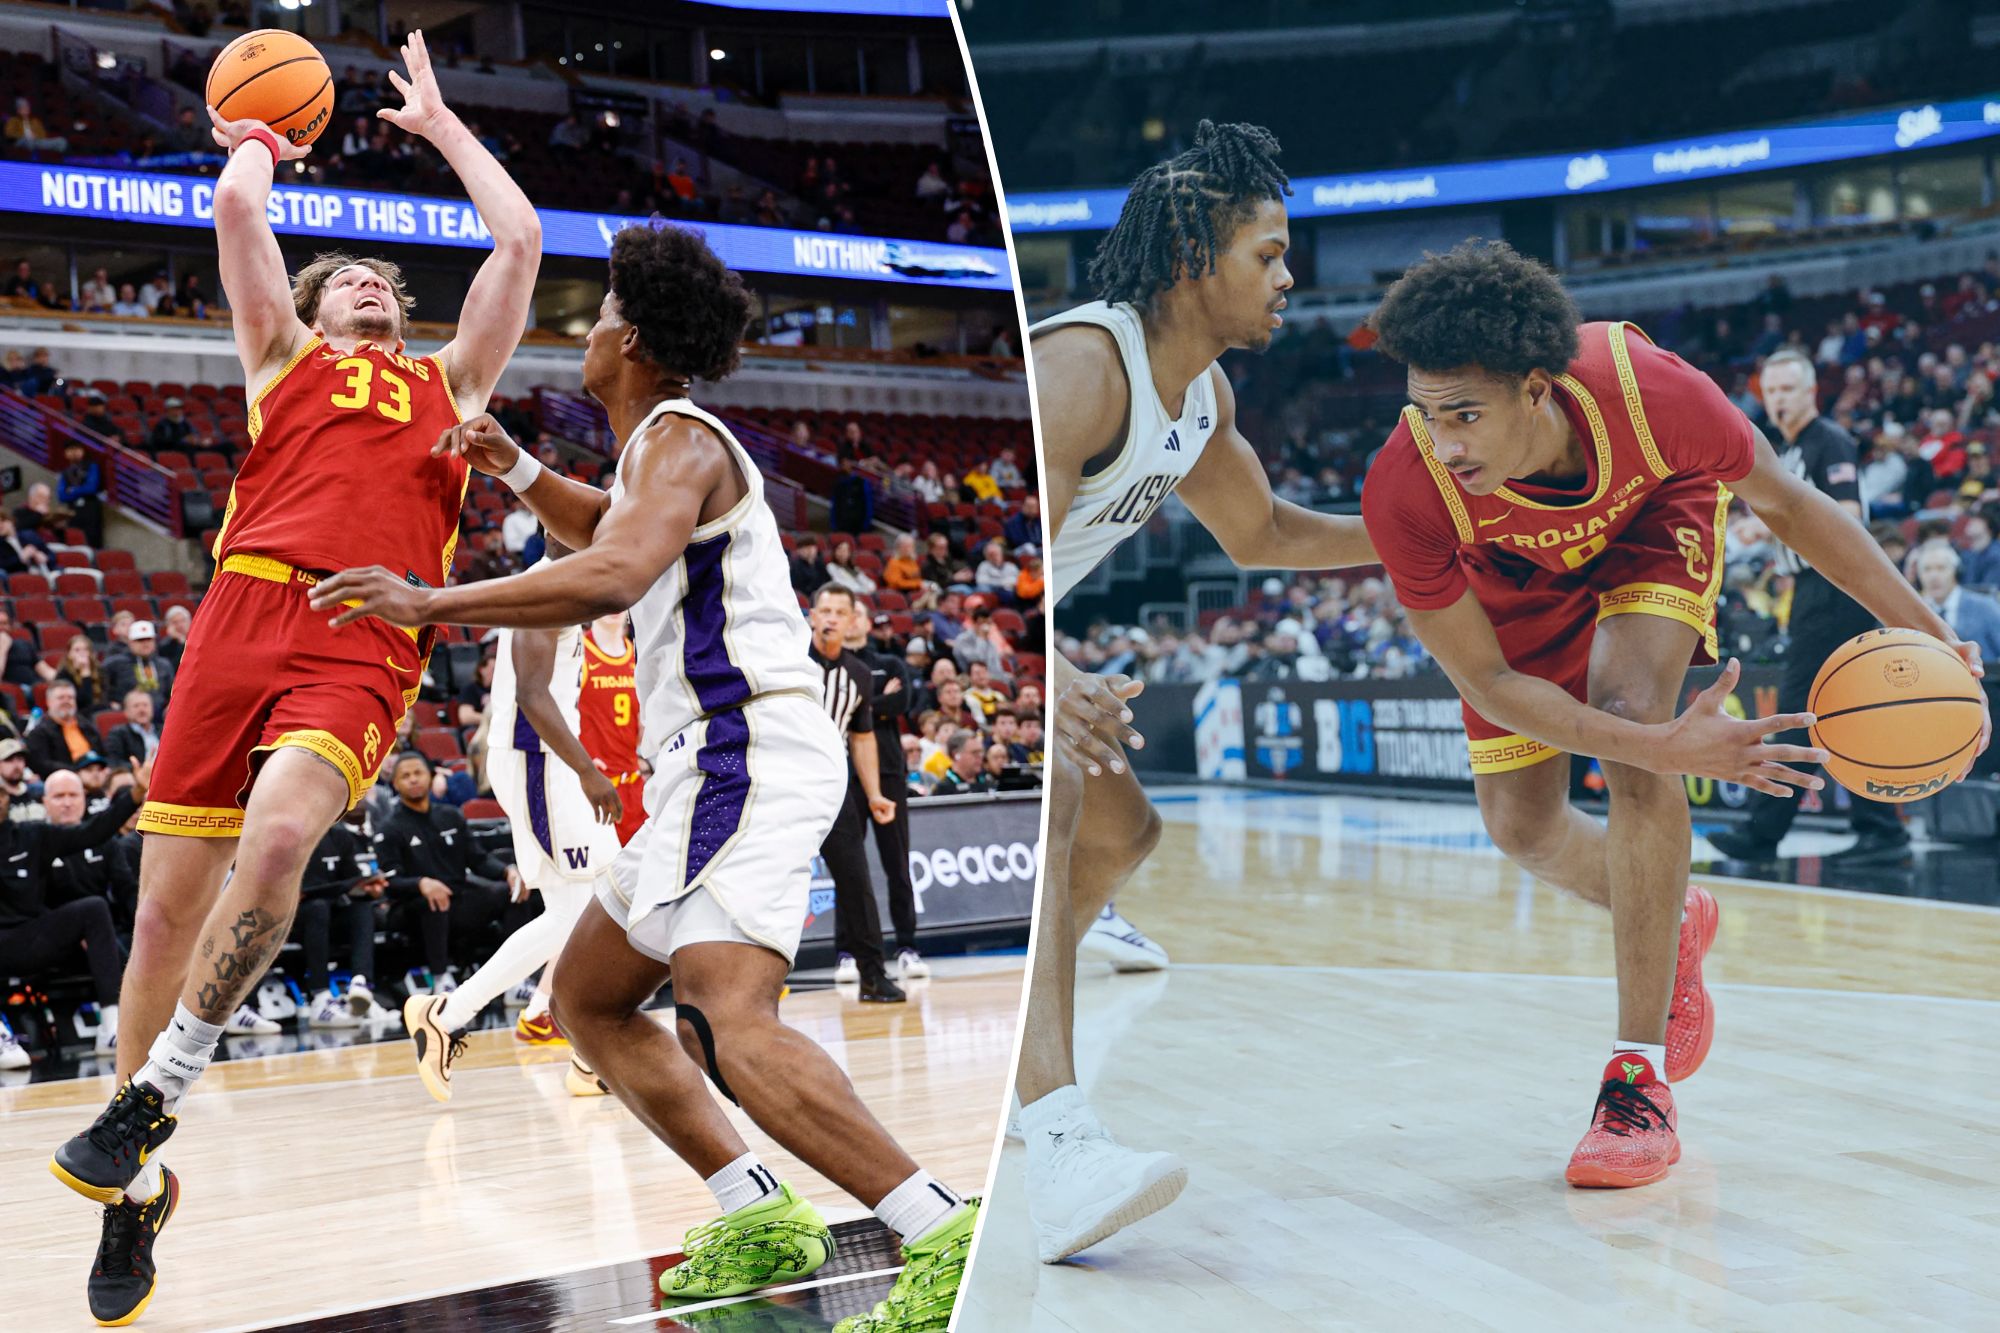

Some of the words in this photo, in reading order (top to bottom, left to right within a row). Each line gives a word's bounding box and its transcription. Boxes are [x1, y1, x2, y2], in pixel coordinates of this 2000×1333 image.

[286, 107, 328, 143] lson
[41, 172, 183, 217] NOTHING
[267, 190, 343, 228] STOP
[348, 196, 416, 235] THIS
[331, 357, 411, 423] 33
[590, 675, 636, 690] TROJAN
[613, 692, 631, 726] 9
[1865, 772, 1949, 798] NCAA
[562, 846, 589, 869] W
[909, 841, 1039, 914] peaco
